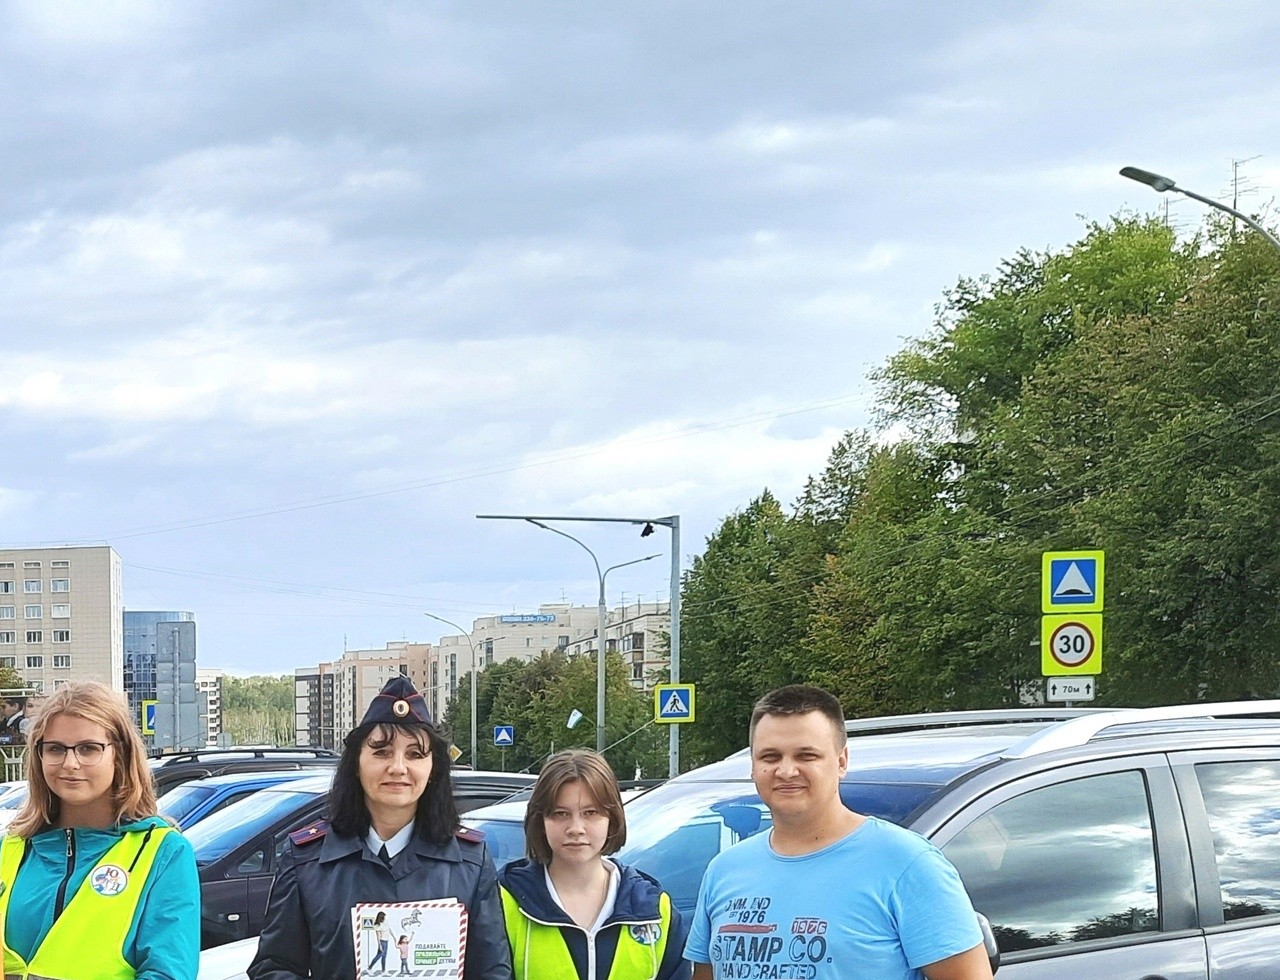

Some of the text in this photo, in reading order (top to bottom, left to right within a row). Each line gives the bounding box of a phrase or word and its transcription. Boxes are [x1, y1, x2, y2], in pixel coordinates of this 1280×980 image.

[1059, 634, 1085, 654] 30
[1062, 685, 1080, 693] 70м
[738, 910, 766, 923] 1976
[791, 920, 827, 934] 1976
[712, 935, 833, 964] STAMP CO.
[721, 962, 817, 980] HANDCRAFTED
